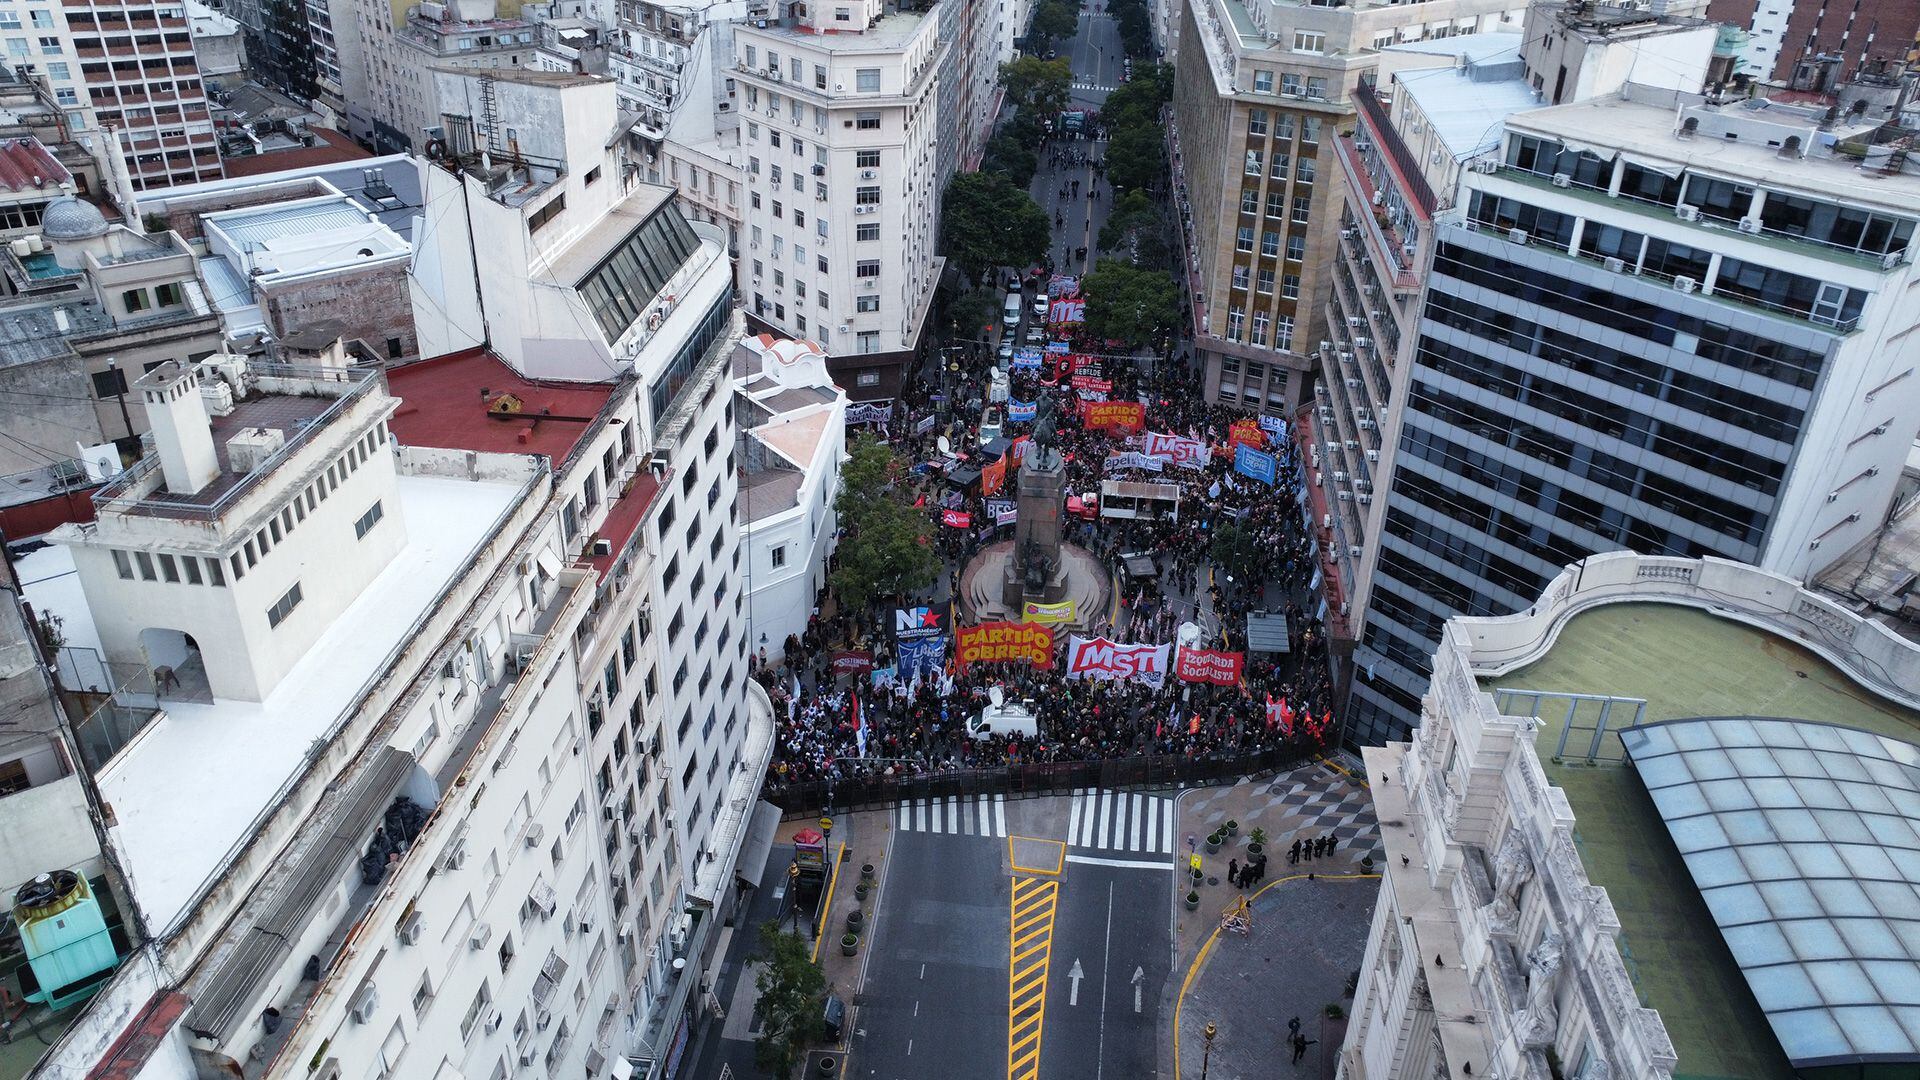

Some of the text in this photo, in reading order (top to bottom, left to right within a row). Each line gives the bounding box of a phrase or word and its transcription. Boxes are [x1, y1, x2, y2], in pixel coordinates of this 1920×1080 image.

[1074, 368, 1102, 377] REBELDE
[1091, 405, 1140, 415] PARTIDO
[1092, 415, 1138, 424] OBERO
[1233, 429, 1252, 440] PCR
[1154, 437, 1200, 461] MST
[962, 627, 1051, 649] PARTIDO
[963, 645, 1047, 664] OBRERO
[1079, 644, 1156, 678] MST
[1185, 652, 1234, 668] IZQUIERDA
[1182, 663, 1234, 681] SOCIALISTA
